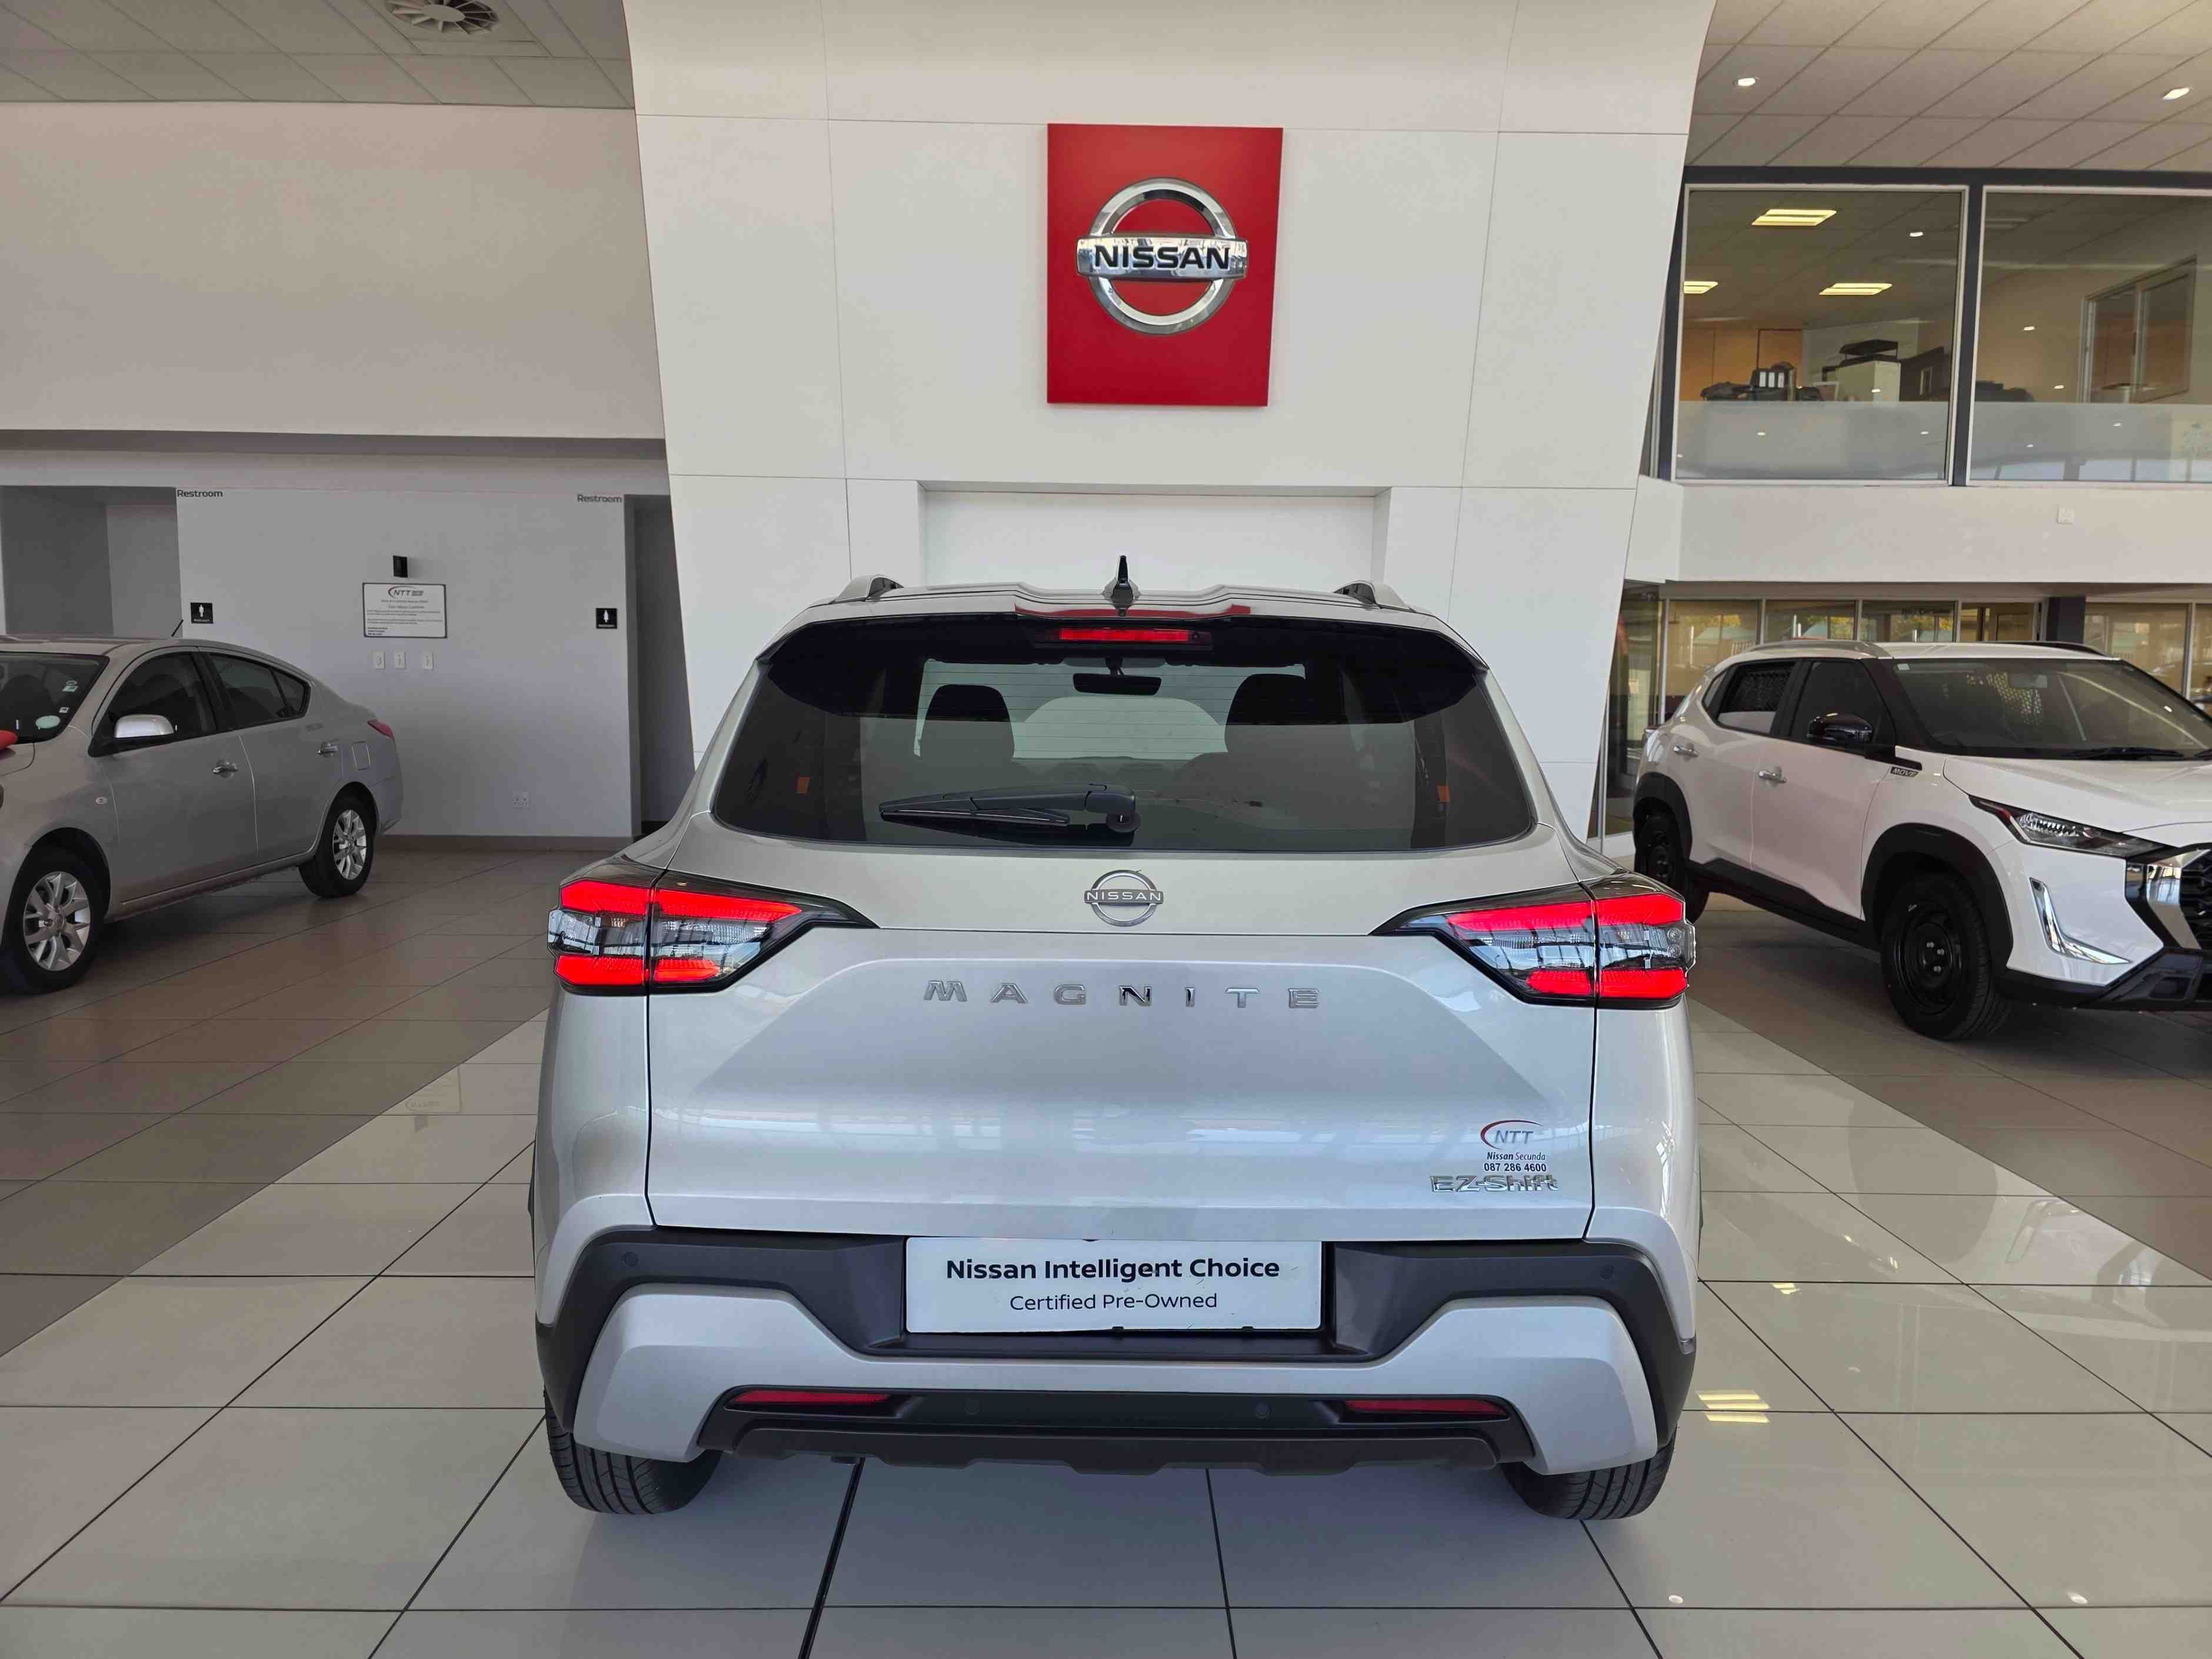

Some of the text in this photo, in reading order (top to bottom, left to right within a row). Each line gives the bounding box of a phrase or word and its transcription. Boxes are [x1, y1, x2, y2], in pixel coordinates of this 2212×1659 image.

[1094, 244, 1230, 269] NISSAN
[177, 489, 223, 498] Restroom
[577, 494, 622, 503] Restroom
[1892, 768, 1917, 777] MOVE
[1087, 891, 1161, 902] NISSAN
[924, 980, 1319, 1008] MAGNITE
[1494, 1130, 1534, 1144] NTT
[1487, 1152, 1546, 1161] Nissan Secunda
[1484, 1162, 1547, 1172] 087 286 4600
[947, 1258, 1280, 1283] Nissan Intelligent Choice
[1010, 1292, 1218, 1311] Certified Pre-Owned
